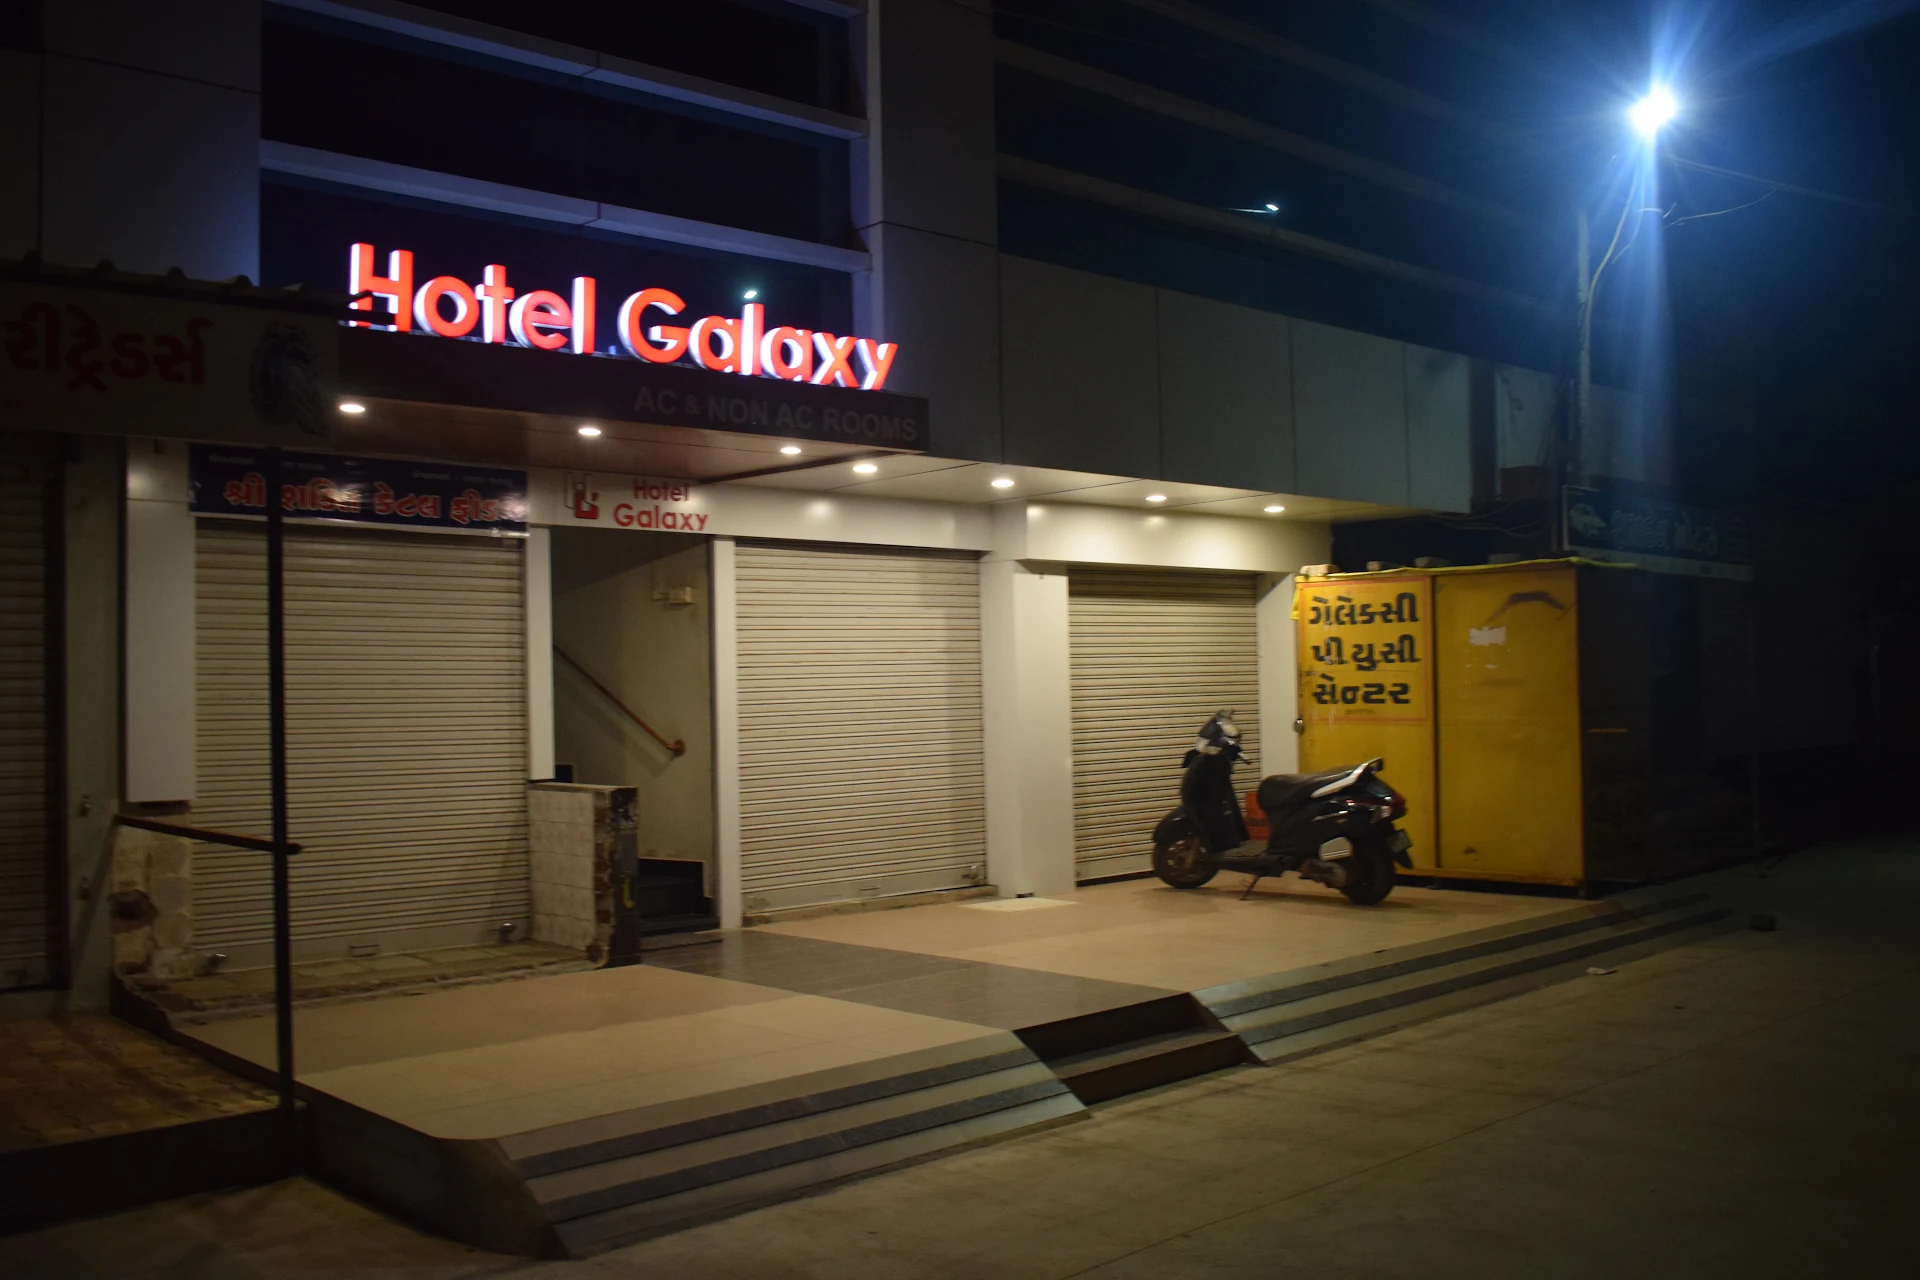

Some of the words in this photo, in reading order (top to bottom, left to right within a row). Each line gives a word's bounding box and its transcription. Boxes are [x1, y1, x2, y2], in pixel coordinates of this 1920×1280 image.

[349, 242, 596, 354] Hotel
[617, 287, 899, 391] Galaxy
[633, 386, 678, 415] AC
[684, 395, 701, 415] &
[708, 396, 769, 426] NON
[775, 403, 813, 430] AC
[823, 407, 918, 442] ROOMS
[633, 478, 690, 502] Hotel
[613, 503, 709, 532] Galaxy
